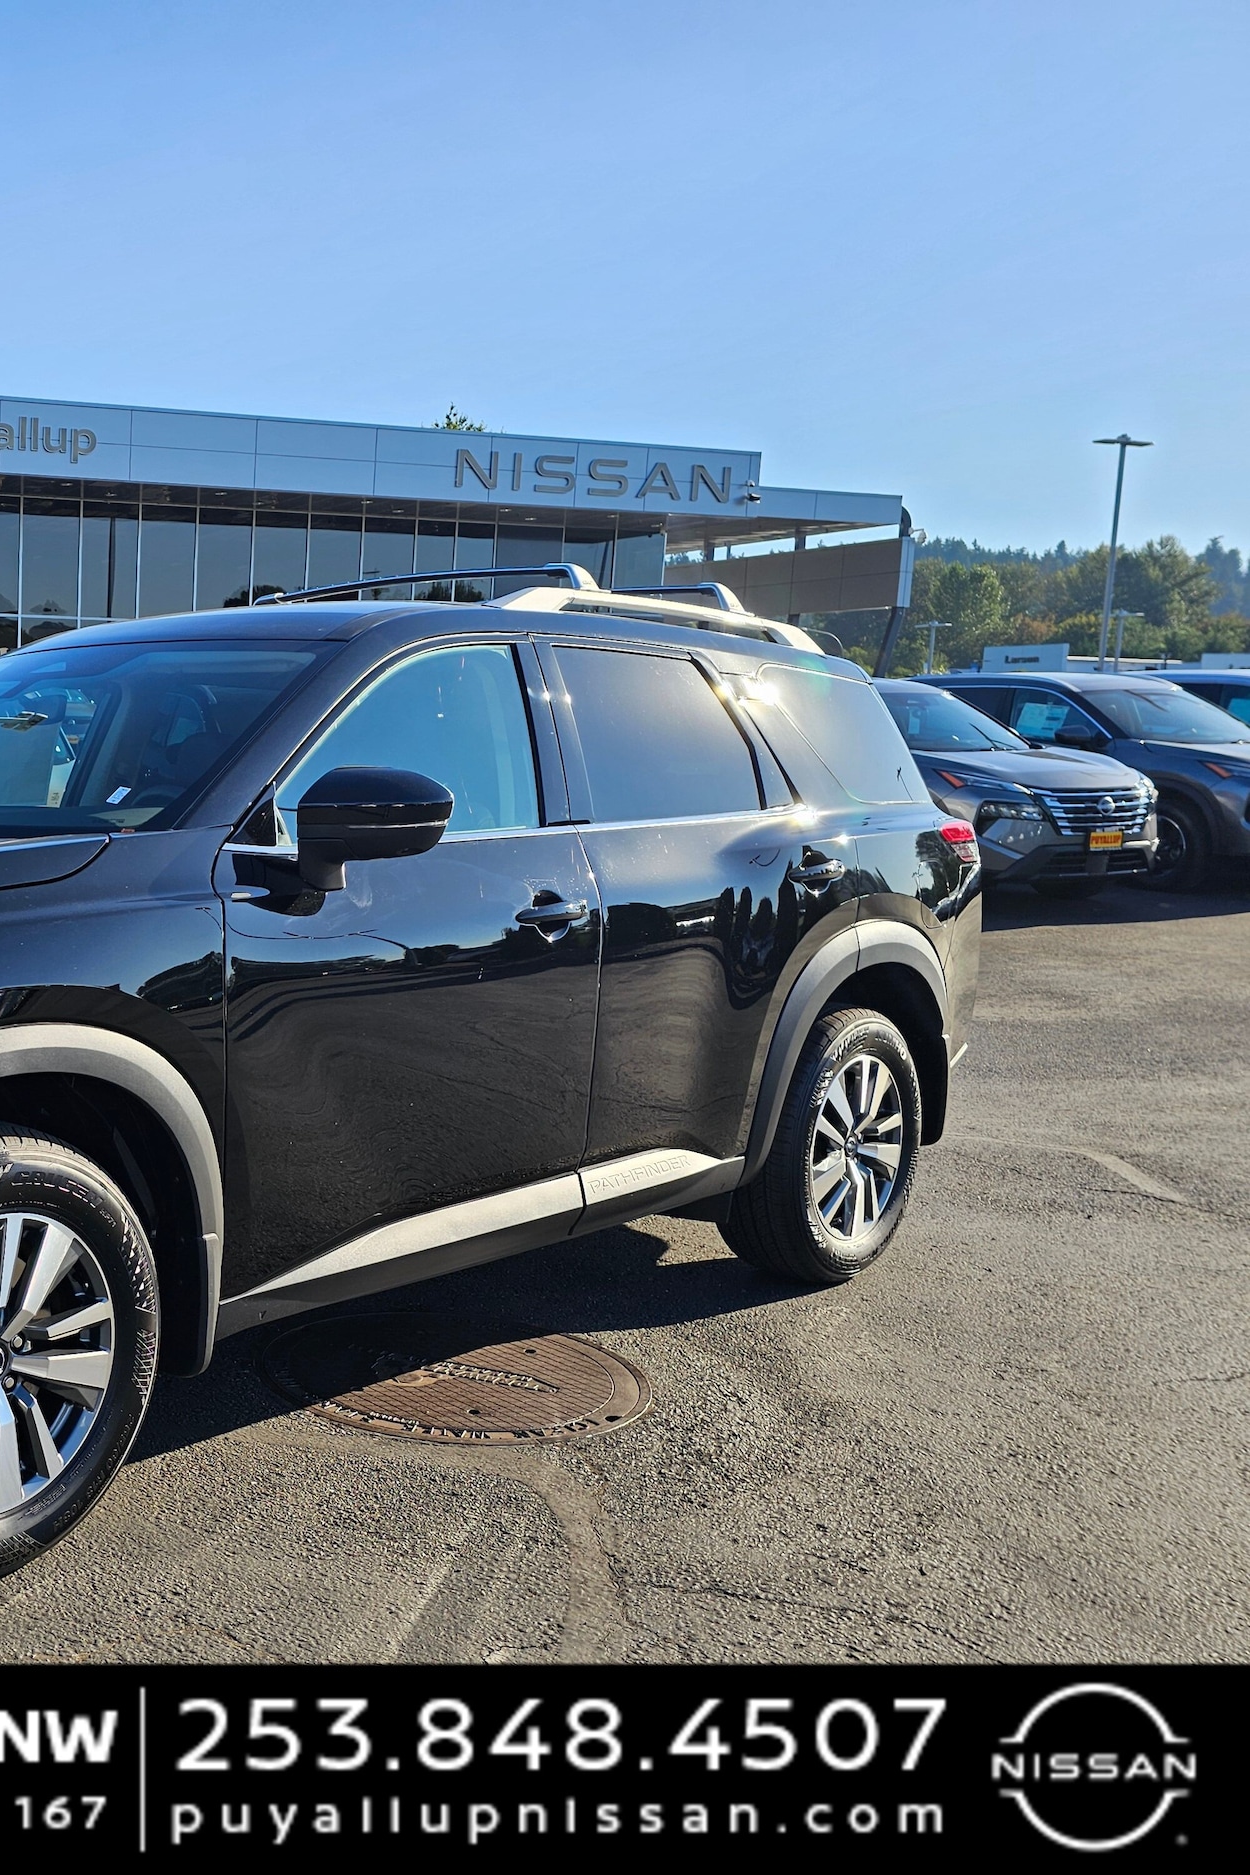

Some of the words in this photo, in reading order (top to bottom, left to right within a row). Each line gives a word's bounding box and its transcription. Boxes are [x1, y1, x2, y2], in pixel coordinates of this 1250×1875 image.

[455, 448, 732, 503] NISSAN
[1091, 834, 1121, 844] PUYALLUP
[587, 1154, 692, 1194] PATHFINDER
